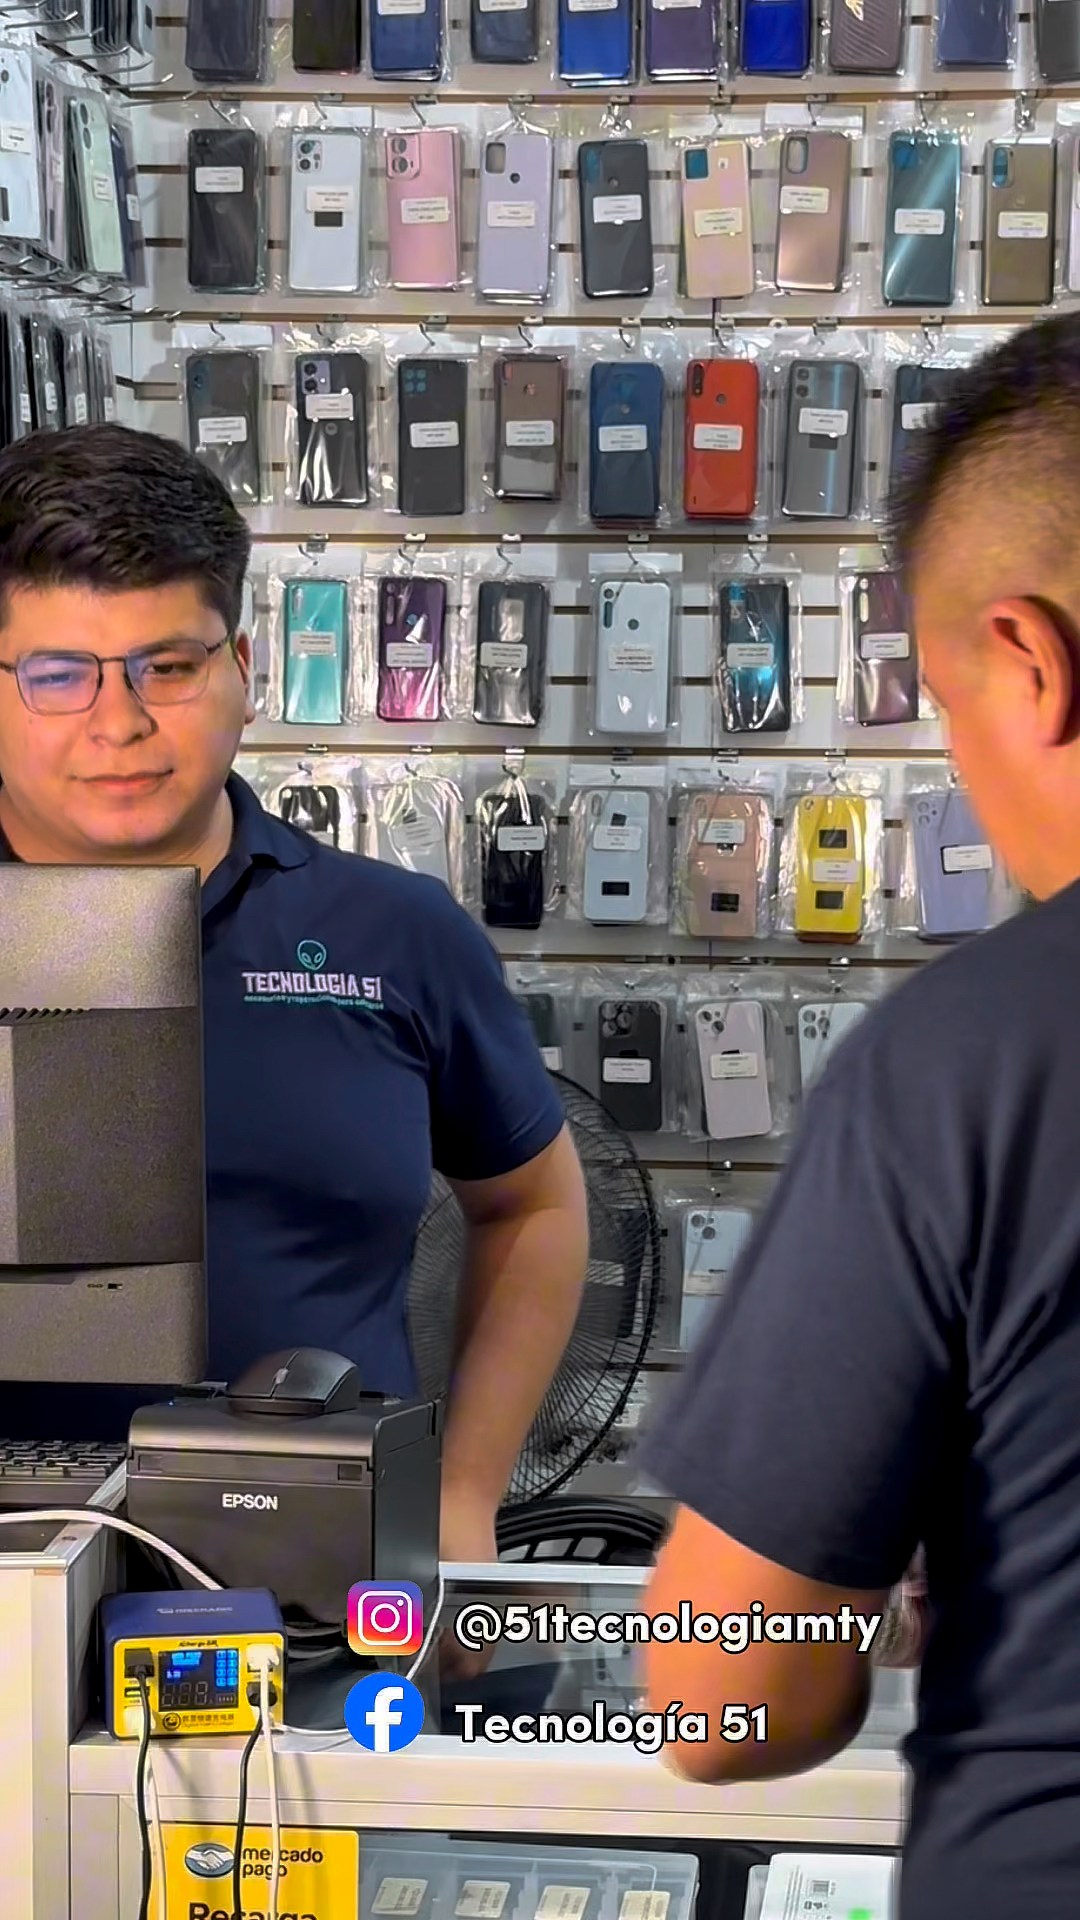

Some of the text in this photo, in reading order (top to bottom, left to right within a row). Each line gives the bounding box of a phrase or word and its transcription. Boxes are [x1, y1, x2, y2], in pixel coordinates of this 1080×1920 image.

[242, 971, 360, 996] TECNOLOGIA
[222, 1493, 278, 1510] EPSON
[242, 1863, 288, 1880] pago
